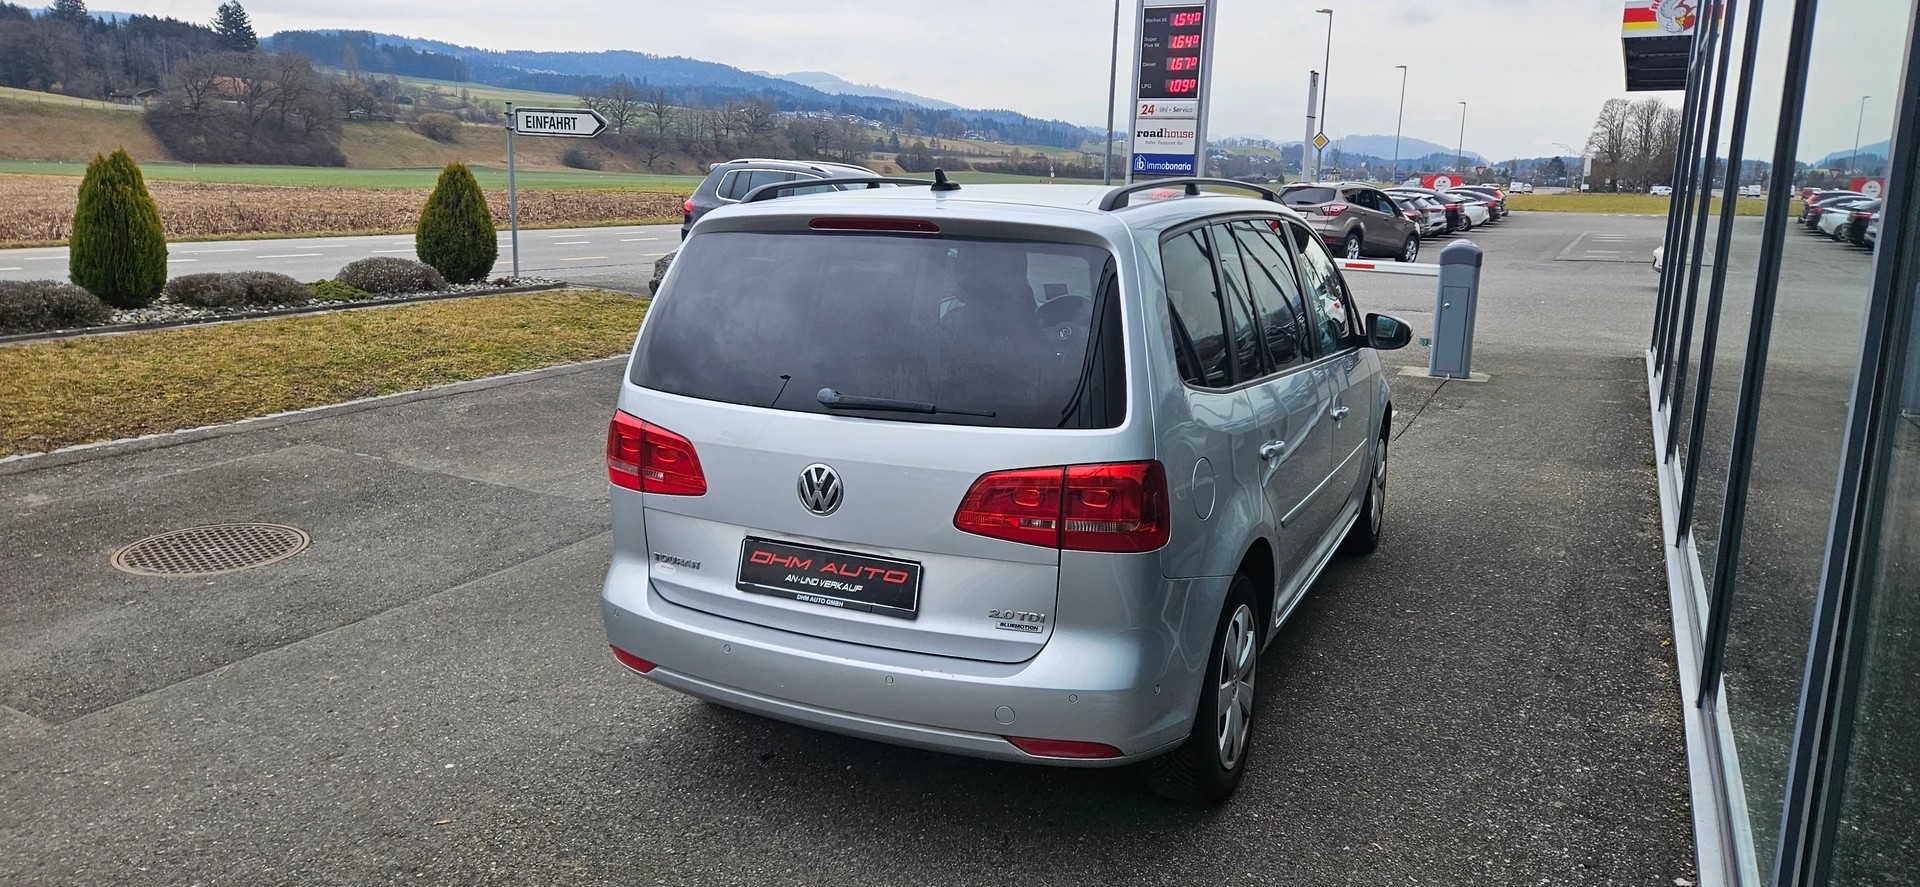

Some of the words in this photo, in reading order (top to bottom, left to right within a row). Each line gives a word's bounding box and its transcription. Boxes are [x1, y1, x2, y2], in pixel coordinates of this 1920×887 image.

[1141, 104, 1155, 115] 24
[526, 116, 577, 130] EINFAHRT
[1136, 128, 1194, 138] roadhouse
[1146, 162, 1192, 170] immobonaria
[654, 552, 700, 570] TOURAN
[820, 562, 908, 584] AUTO
[820, 579, 864, 592] VERKAUF
[989, 608, 1014, 620] 2.0
[1017, 611, 1045, 623] TDI
